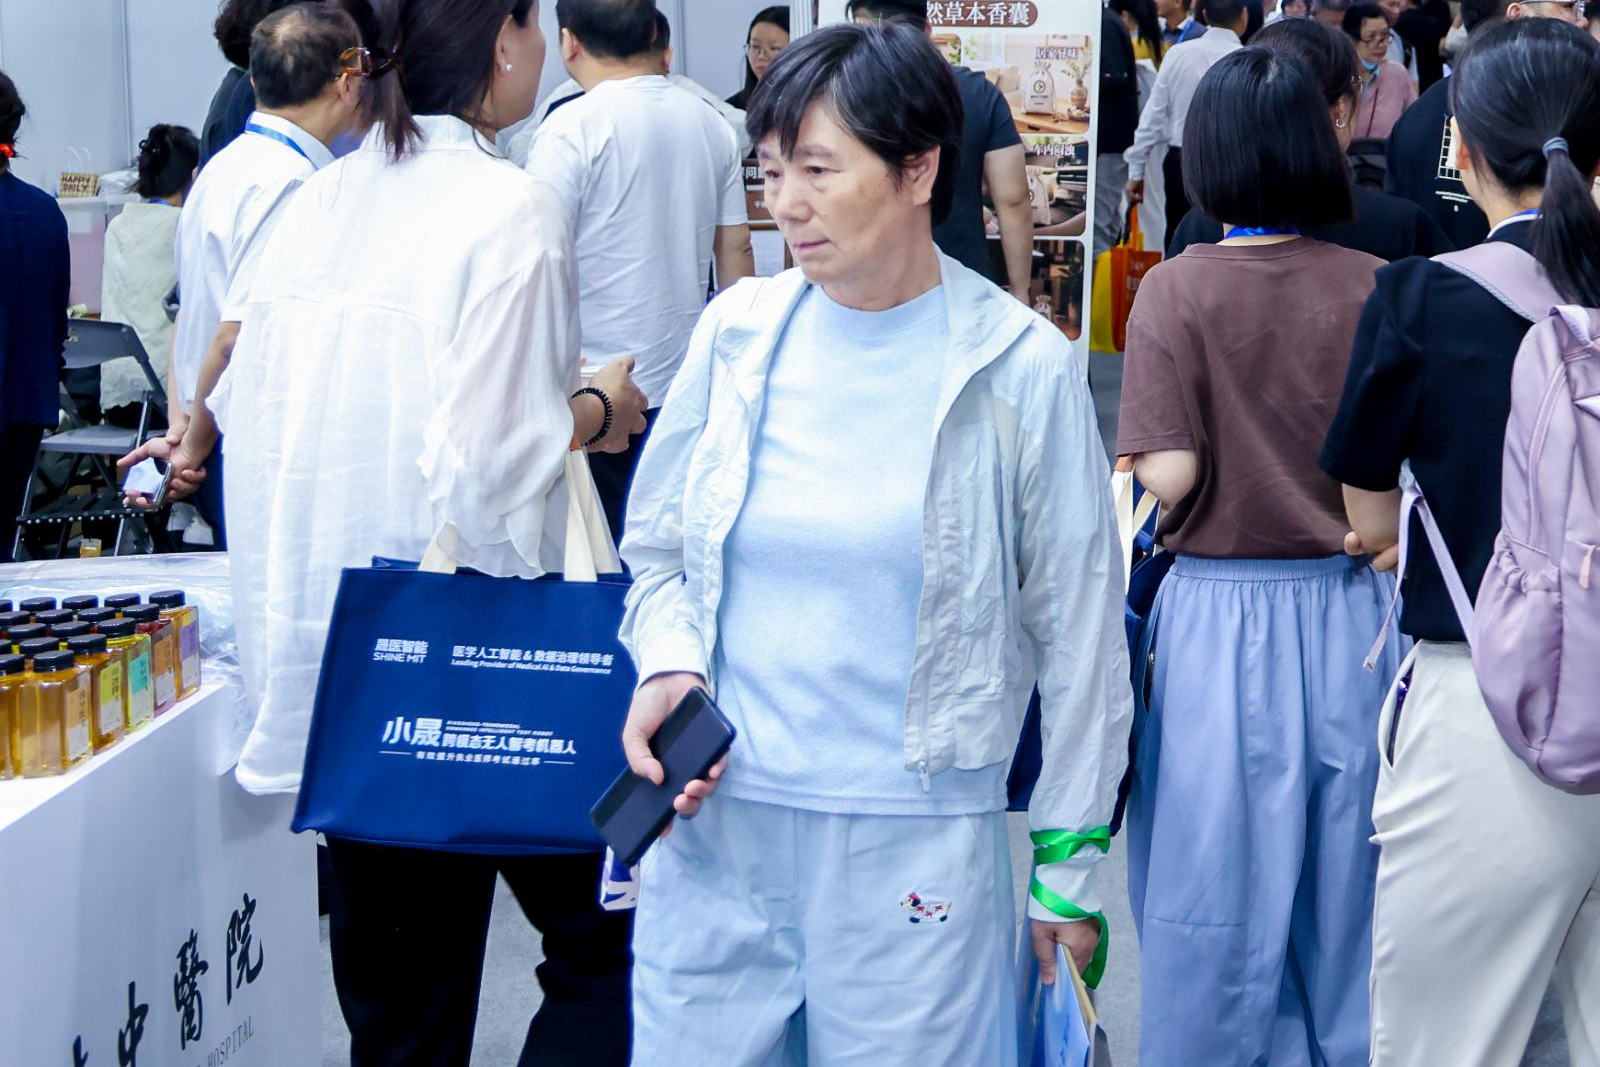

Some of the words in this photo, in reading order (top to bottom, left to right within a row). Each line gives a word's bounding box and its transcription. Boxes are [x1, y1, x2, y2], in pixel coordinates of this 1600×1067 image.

[373, 652, 405, 662] SHINE
[407, 654, 427, 663] MIT
[382, 716, 442, 747] 小晟
